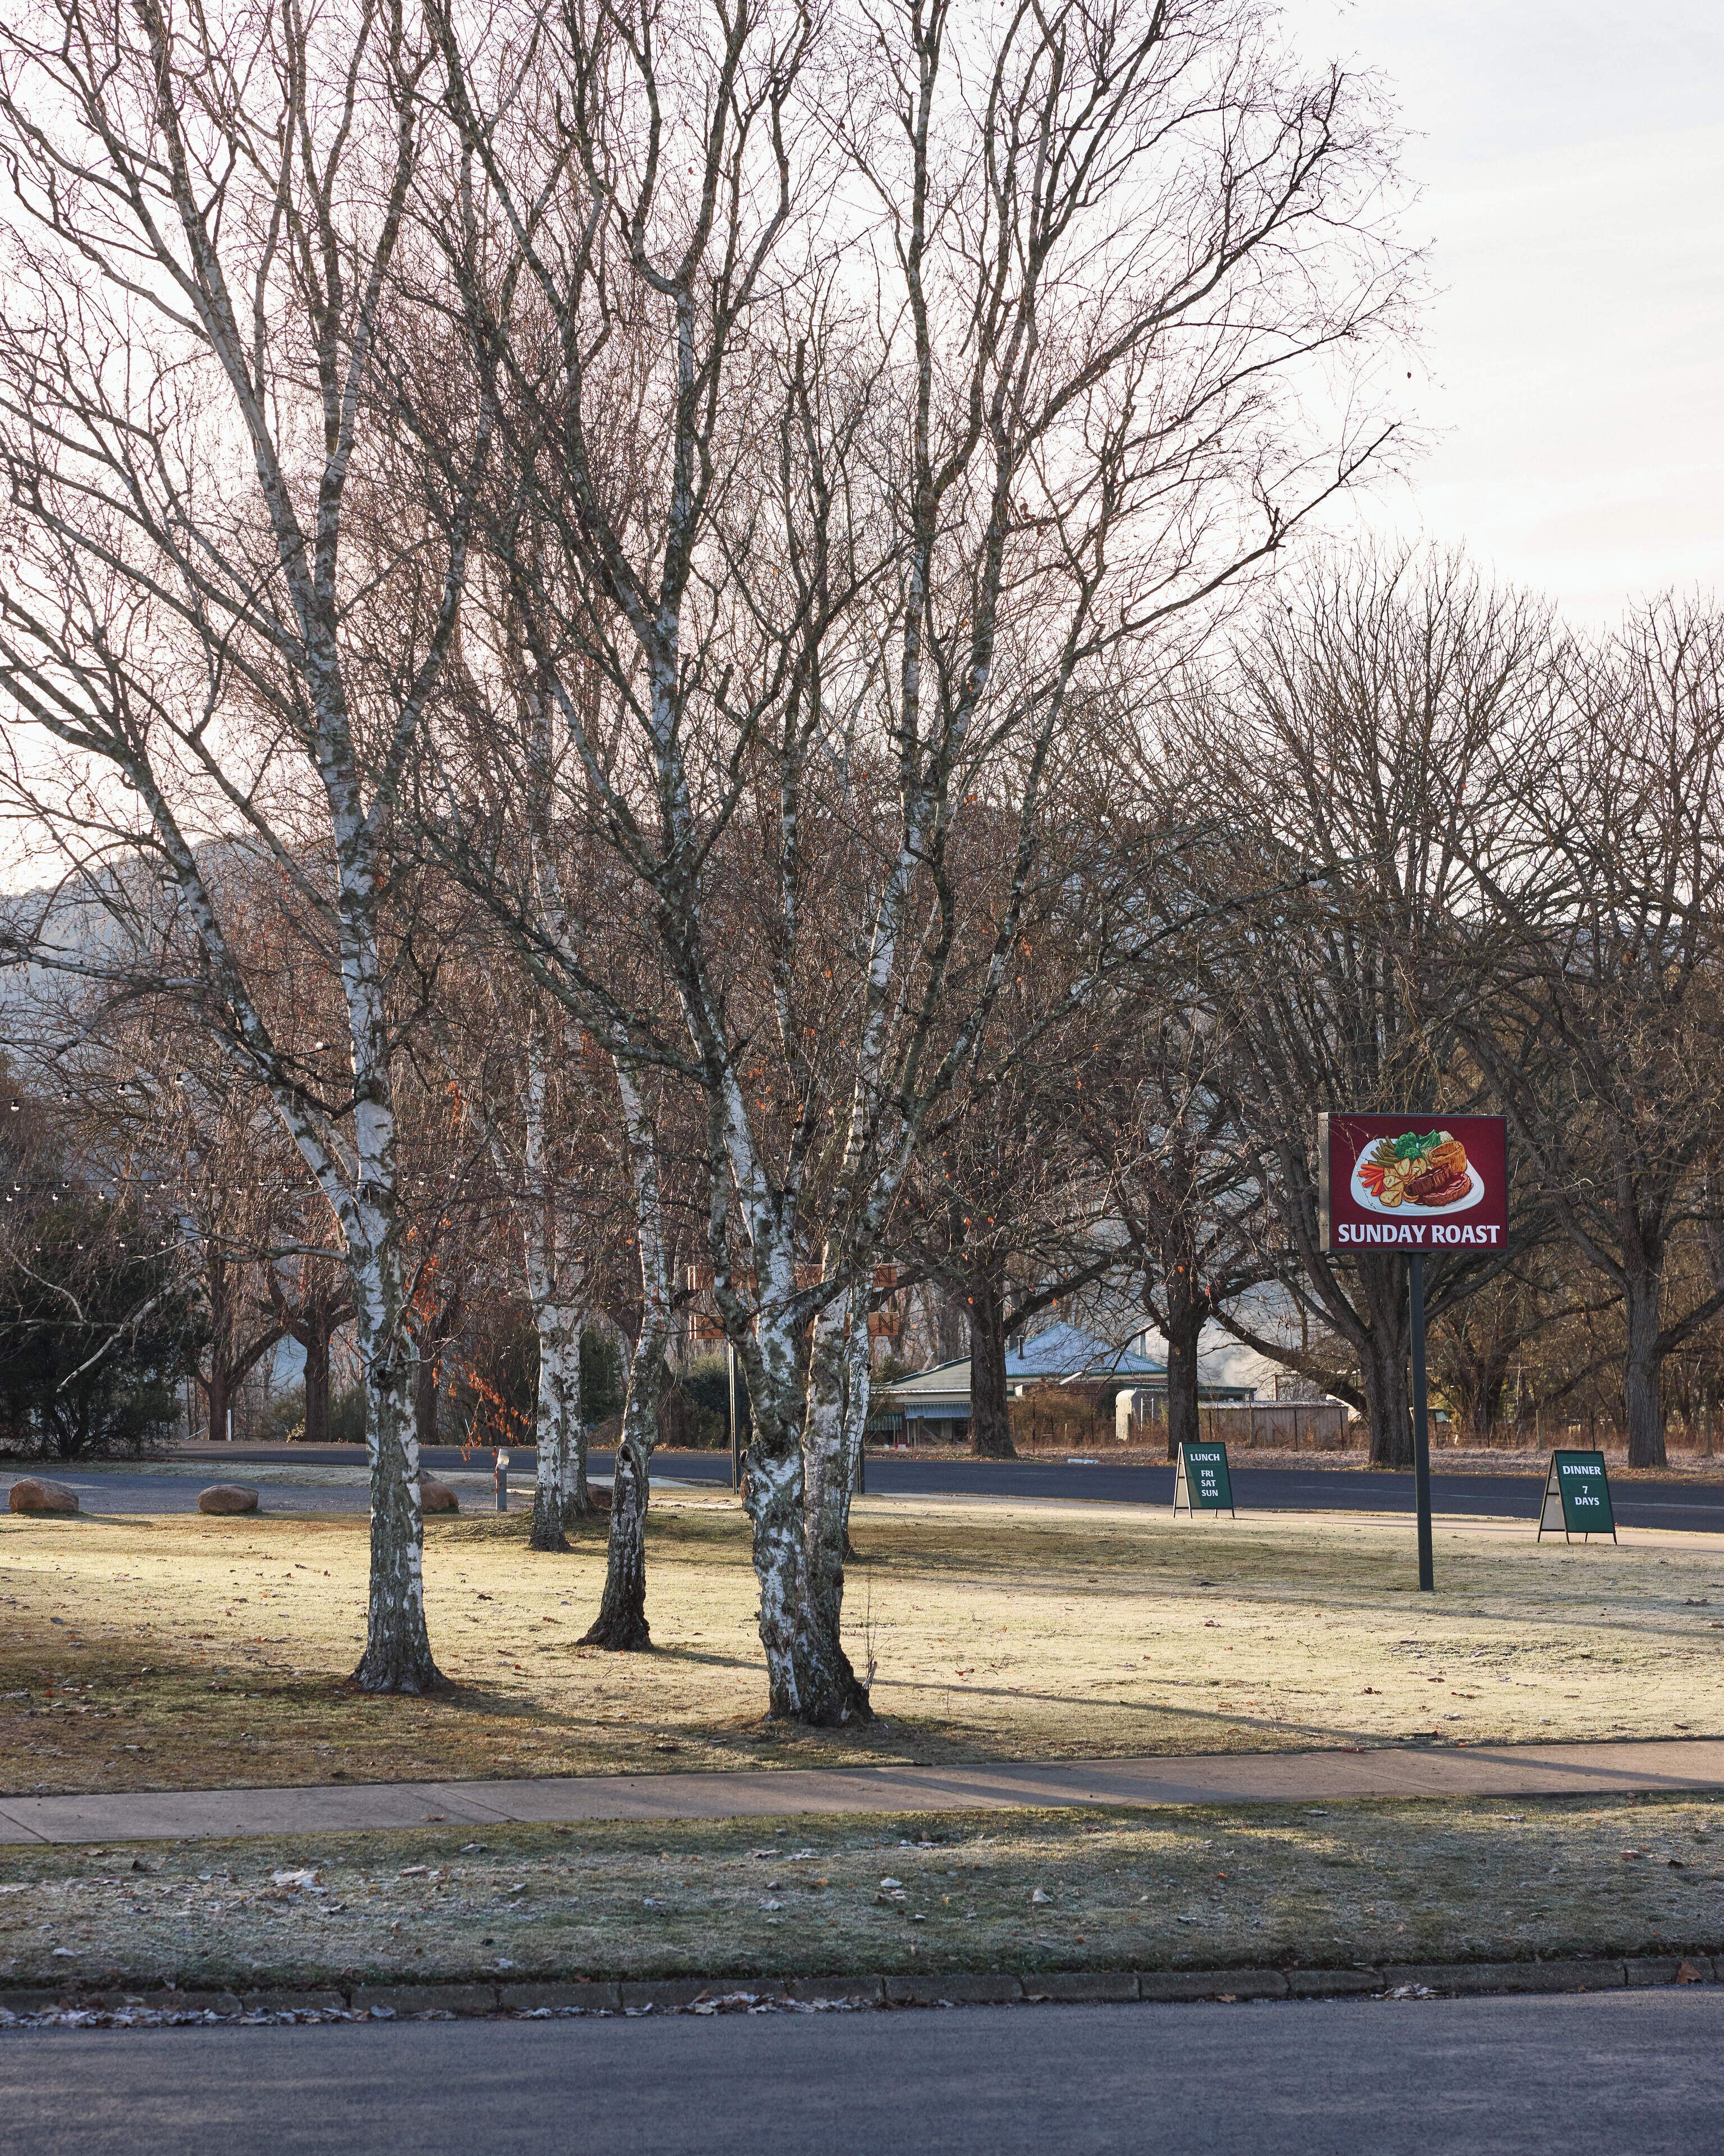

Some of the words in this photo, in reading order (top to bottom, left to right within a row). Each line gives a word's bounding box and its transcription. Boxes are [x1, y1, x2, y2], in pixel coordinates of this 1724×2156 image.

[1338, 1224, 1426, 1243] SUNDAY
[1432, 1225, 1500, 1243] ROAST
[1563, 1466, 1601, 1474] DINNER
